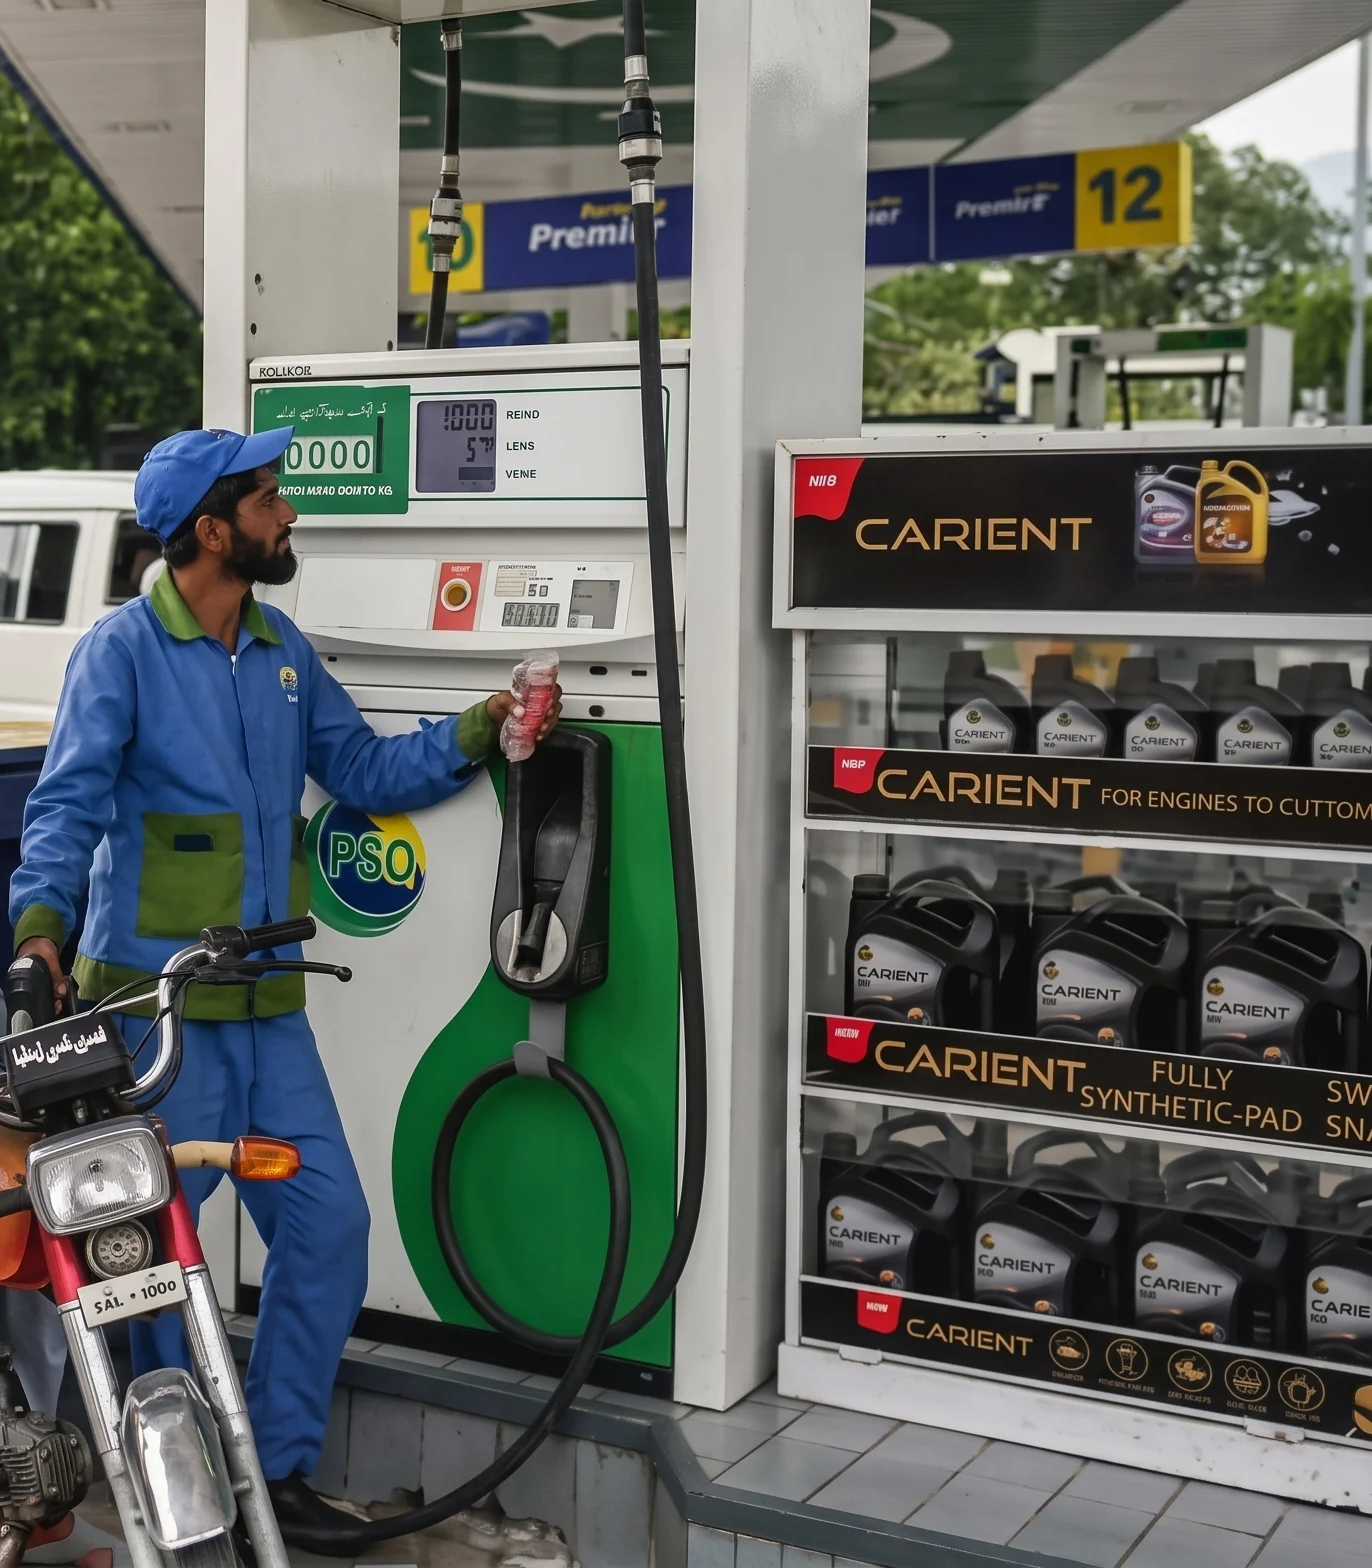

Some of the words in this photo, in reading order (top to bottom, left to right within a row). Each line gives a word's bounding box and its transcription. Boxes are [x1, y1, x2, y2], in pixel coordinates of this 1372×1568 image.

[1089, 164, 1163, 224] 12
[506, 410, 539, 419] REIND
[506, 442, 535, 451] LENS
[855, 518, 1093, 551] CARIENT
[1223, 739, 1282, 751] CARIENT
[878, 769, 1091, 810] CARIENT
[1101, 788, 1142, 807] FOR
[1148, 791, 1238, 812] ENGINES
[1243, 796, 1273, 814] TO
[857, 967, 929, 983] CARIENT
[1041, 984, 1121, 1001] CARIENT
[1206, 1001, 1290, 1020] CARIENT
[875, 1040, 1086, 1093] CARIENT
[1152, 1060, 1233, 1091] FULLY
[1080, 1086, 1303, 1133] SYNTHETIC-PAD
[1326, 1115, 1372, 1143] SN
[829, 1226, 901, 1246] CARIENT
[978, 1254, 1055, 1275] CARIENT
[1139, 1275, 1222, 1298] CARIENT
[906, 1318, 1033, 1356] CARIENT
